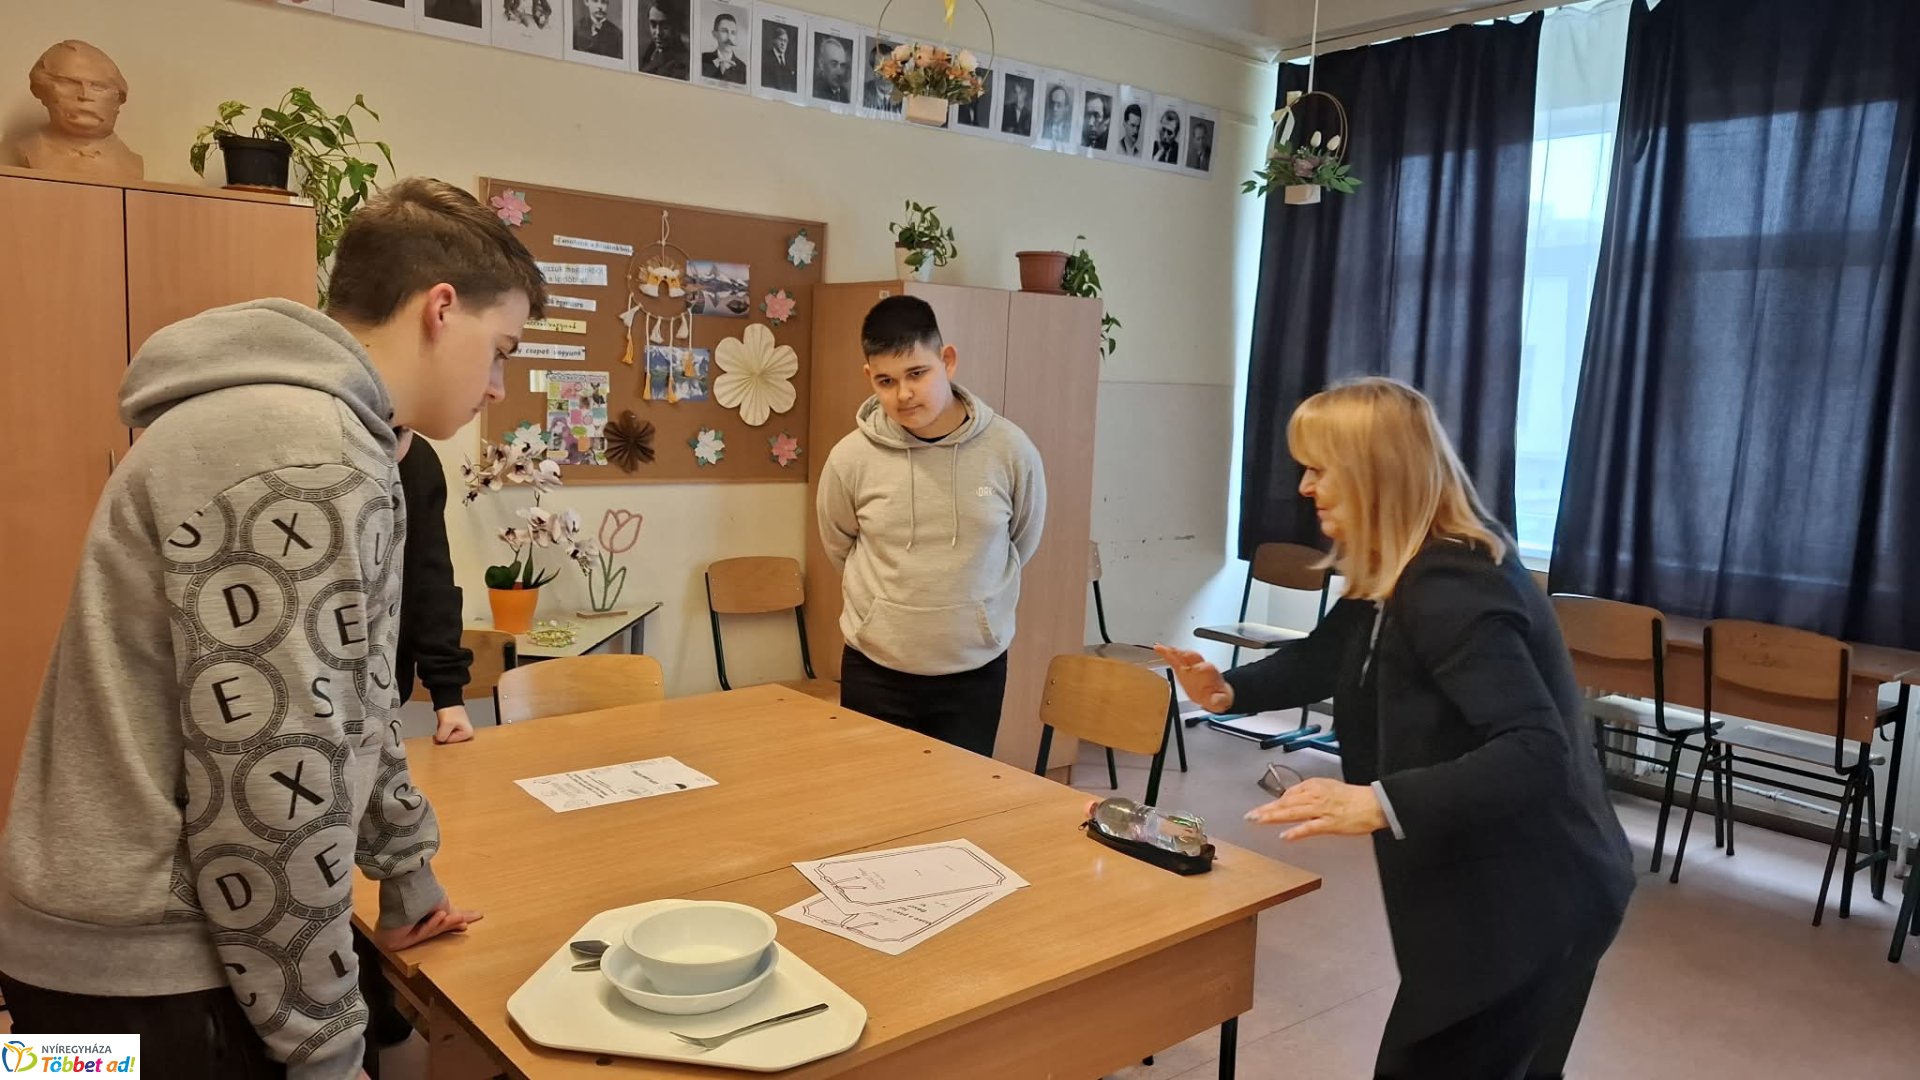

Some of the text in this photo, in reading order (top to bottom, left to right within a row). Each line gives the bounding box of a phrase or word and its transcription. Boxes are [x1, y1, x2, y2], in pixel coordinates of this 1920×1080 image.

[271, 512, 313, 557] X
[222, 583, 260, 629] D
[333, 603, 366, 647] E
[211, 676, 253, 725] E
[311, 676, 335, 719] S
[269, 760, 326, 821] X
[314, 842, 349, 889] E
[215, 872, 253, 912] D
